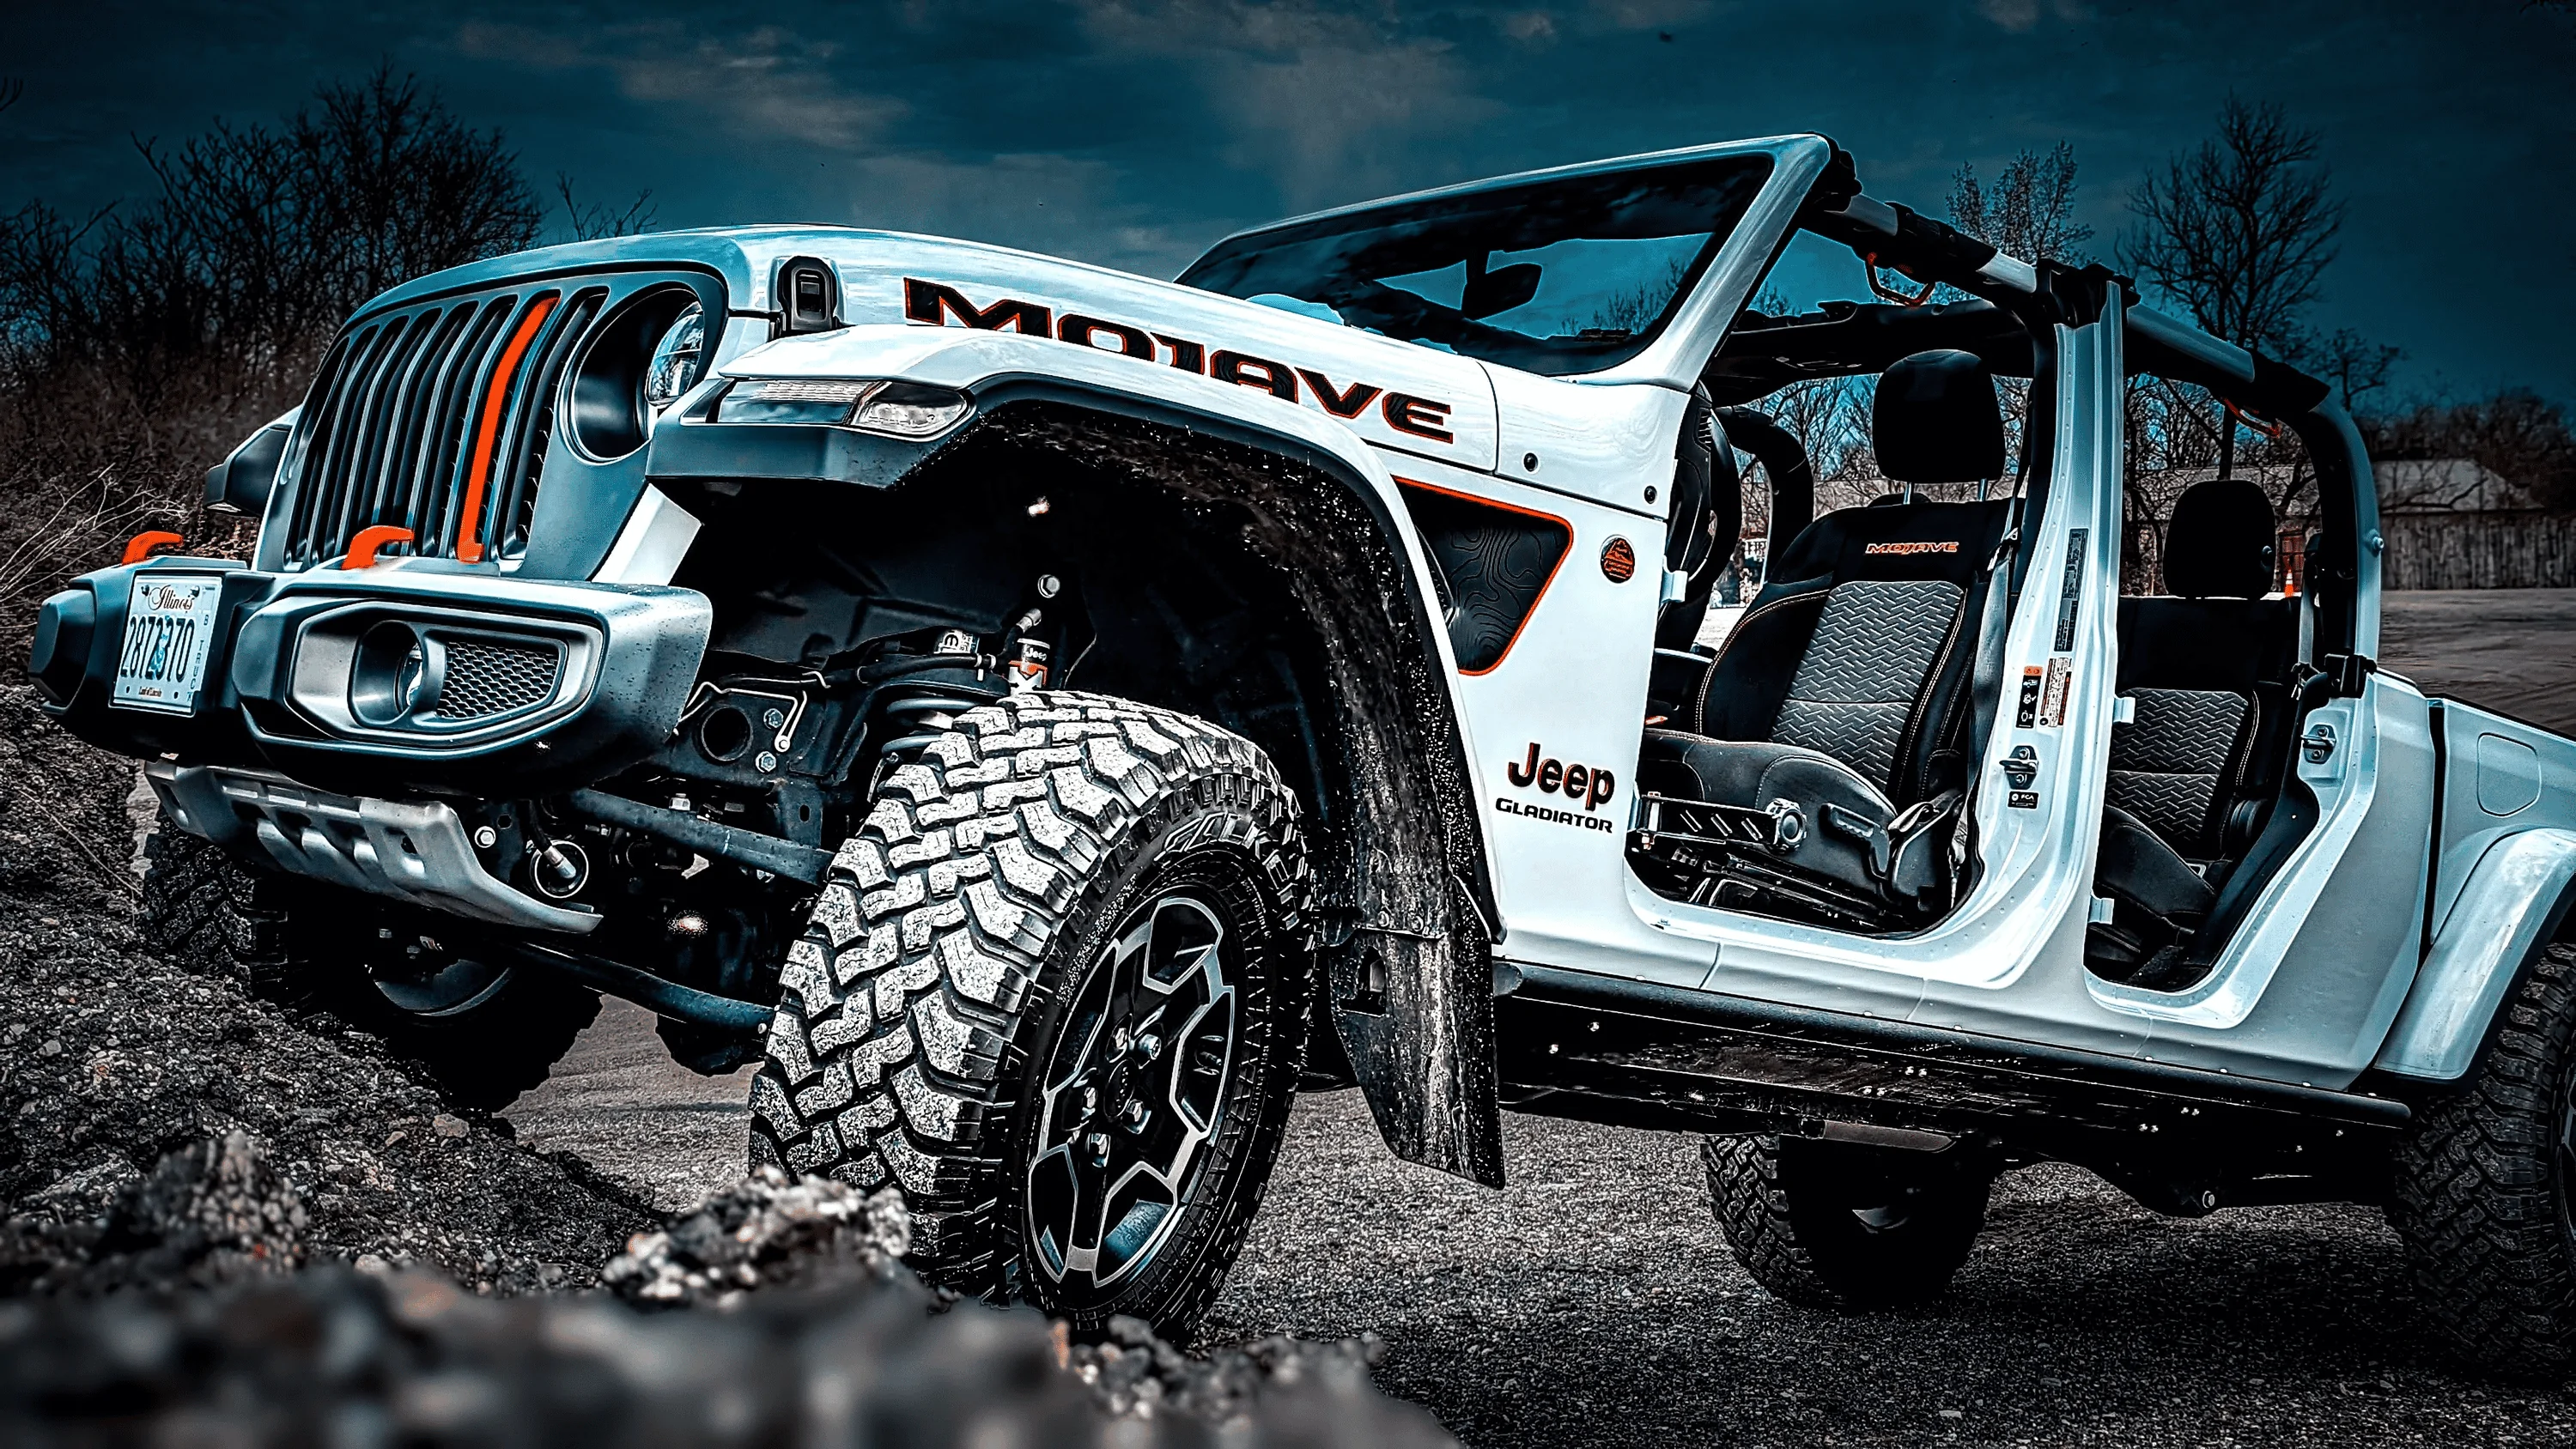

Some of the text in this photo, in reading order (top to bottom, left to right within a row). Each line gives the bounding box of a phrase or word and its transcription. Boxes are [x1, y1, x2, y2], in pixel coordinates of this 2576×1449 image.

[904, 277, 1454, 444] MOJAVE
[1865, 542, 1959, 555] MOJAVE
[148, 585, 196, 610] Illinois
[120, 615, 195, 682] 2872370
[1508, 742, 1615, 812] Jeep
[1495, 797, 1613, 834] GLADIATOR
